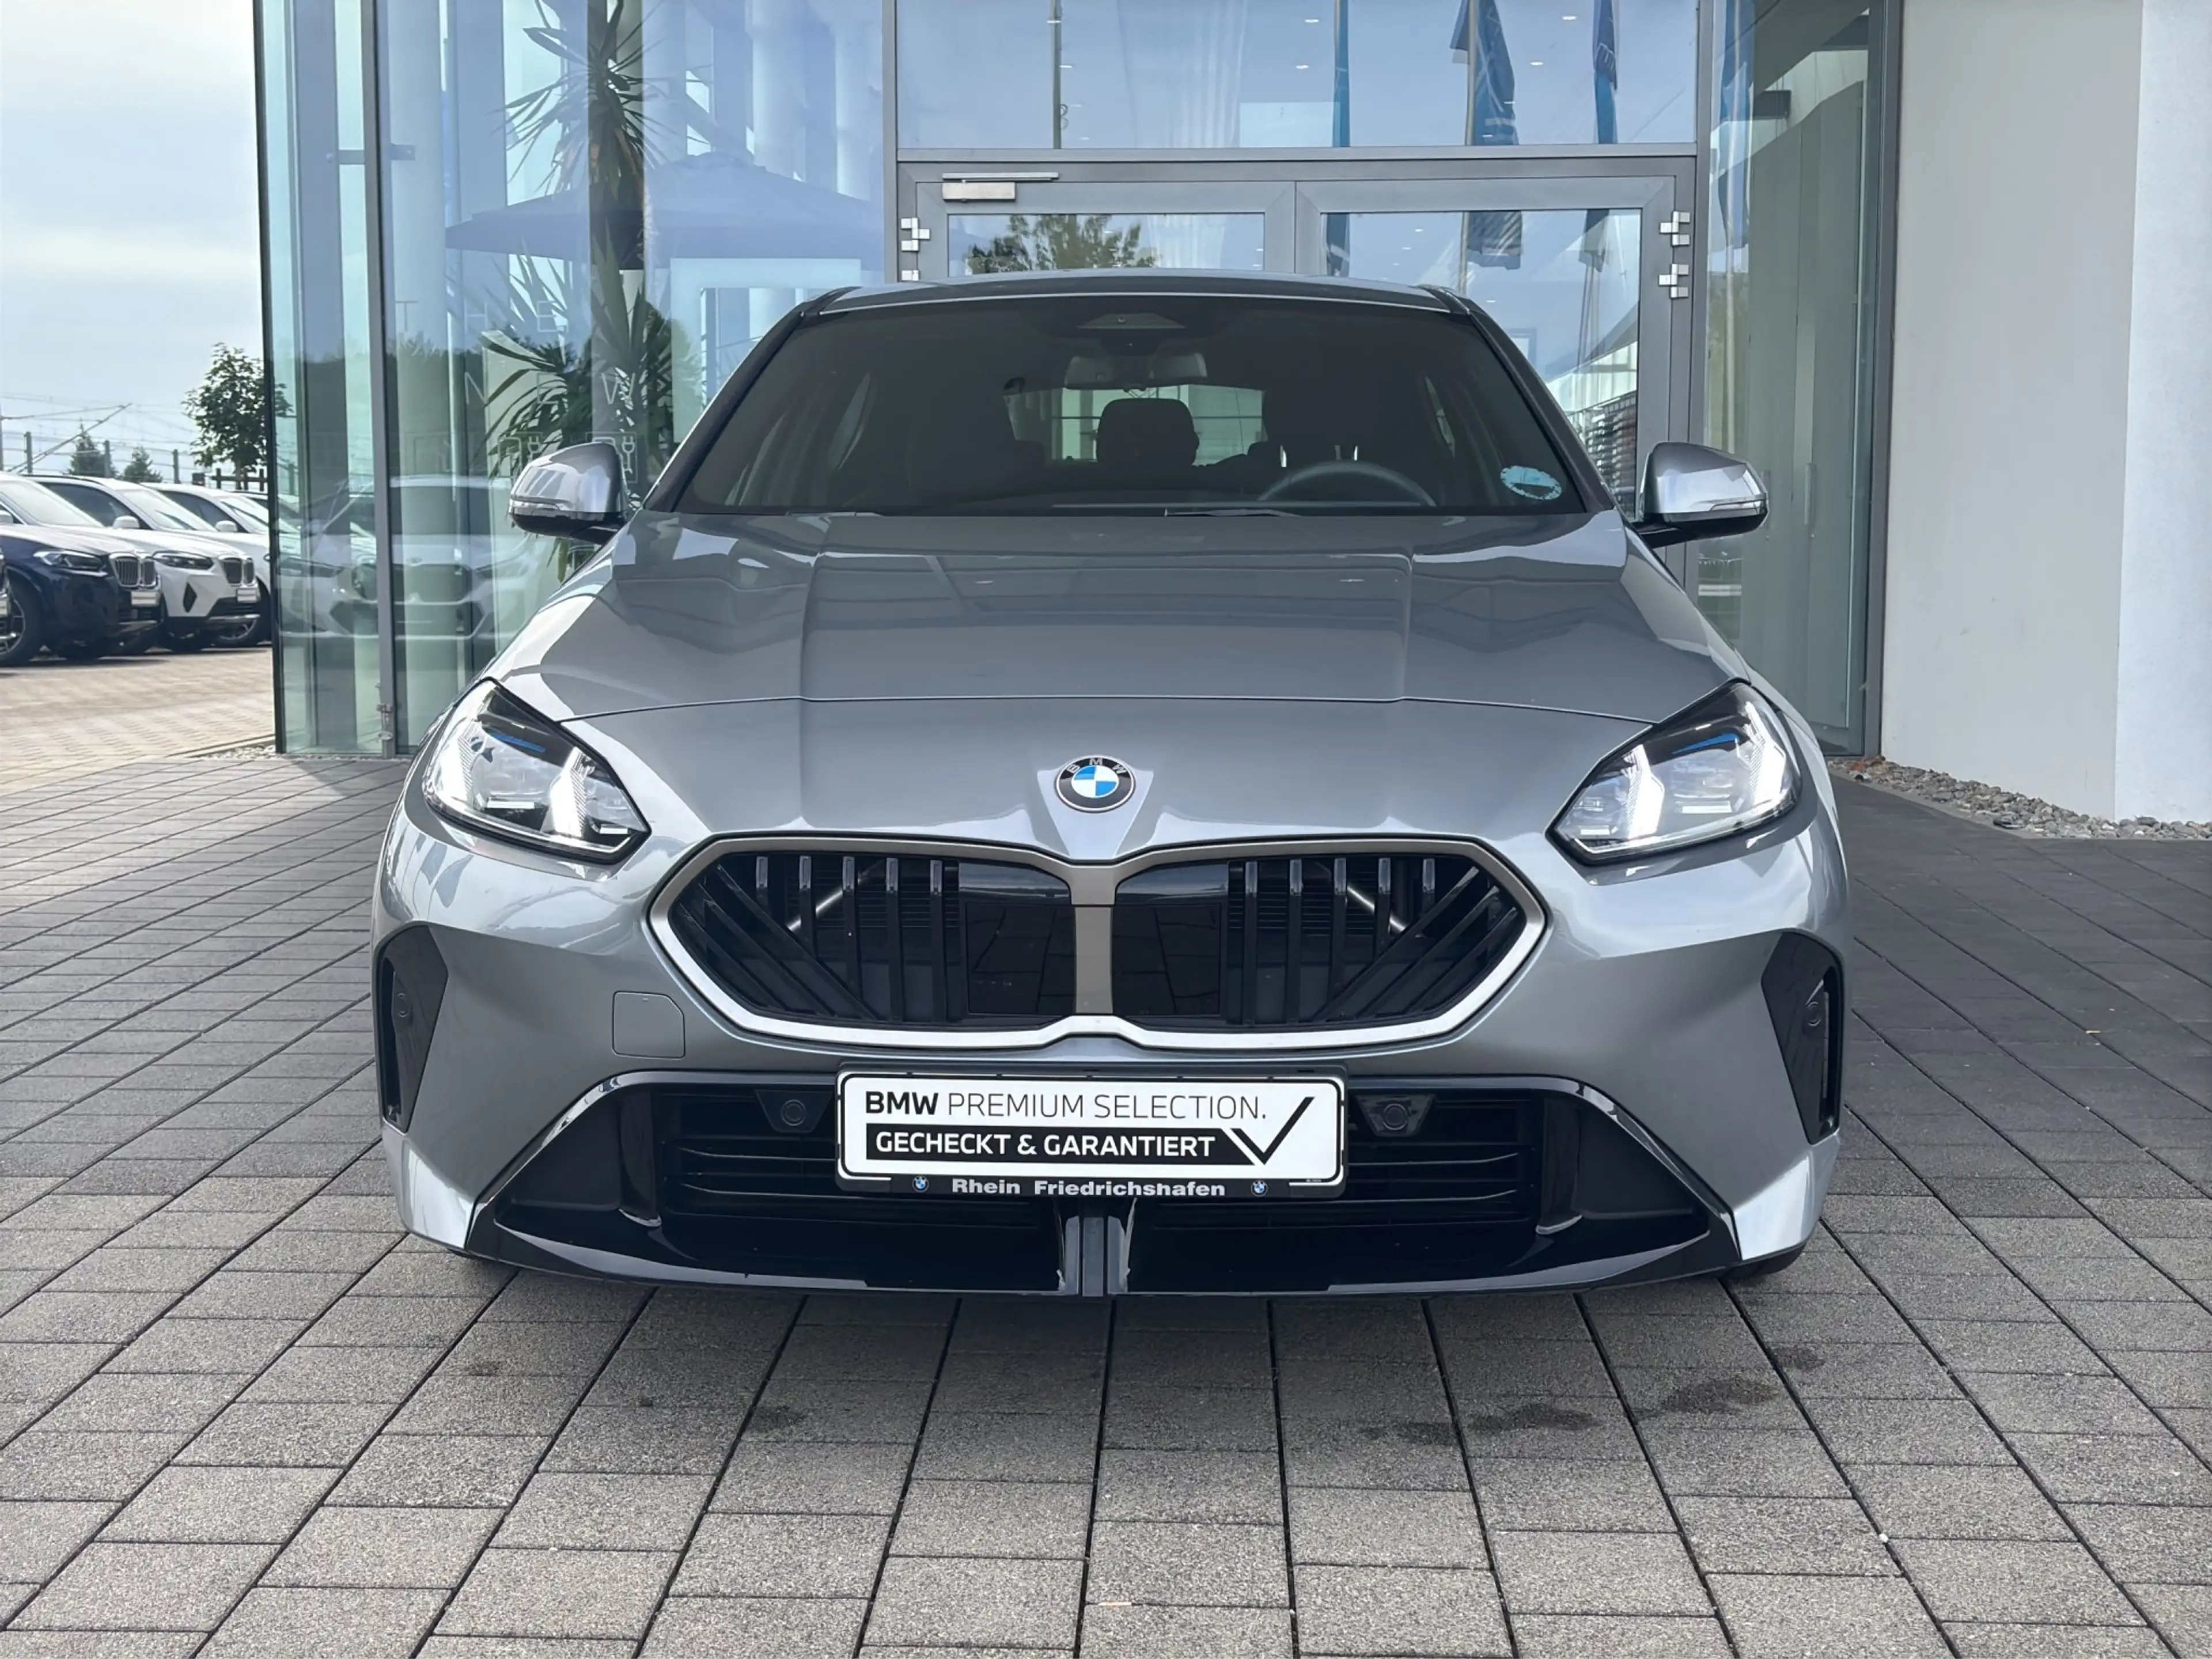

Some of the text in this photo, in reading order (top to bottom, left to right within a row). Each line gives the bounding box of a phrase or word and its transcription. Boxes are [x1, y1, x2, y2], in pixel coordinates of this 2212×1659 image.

[1066, 757, 1126, 774] BMW
[866, 1091, 1266, 1119] BMW PREMIUM SELECTION.
[876, 1131, 1215, 1157] GECHECKT & GARANTIERT
[952, 1178, 1225, 1196] Rhein Friedrichshafen
